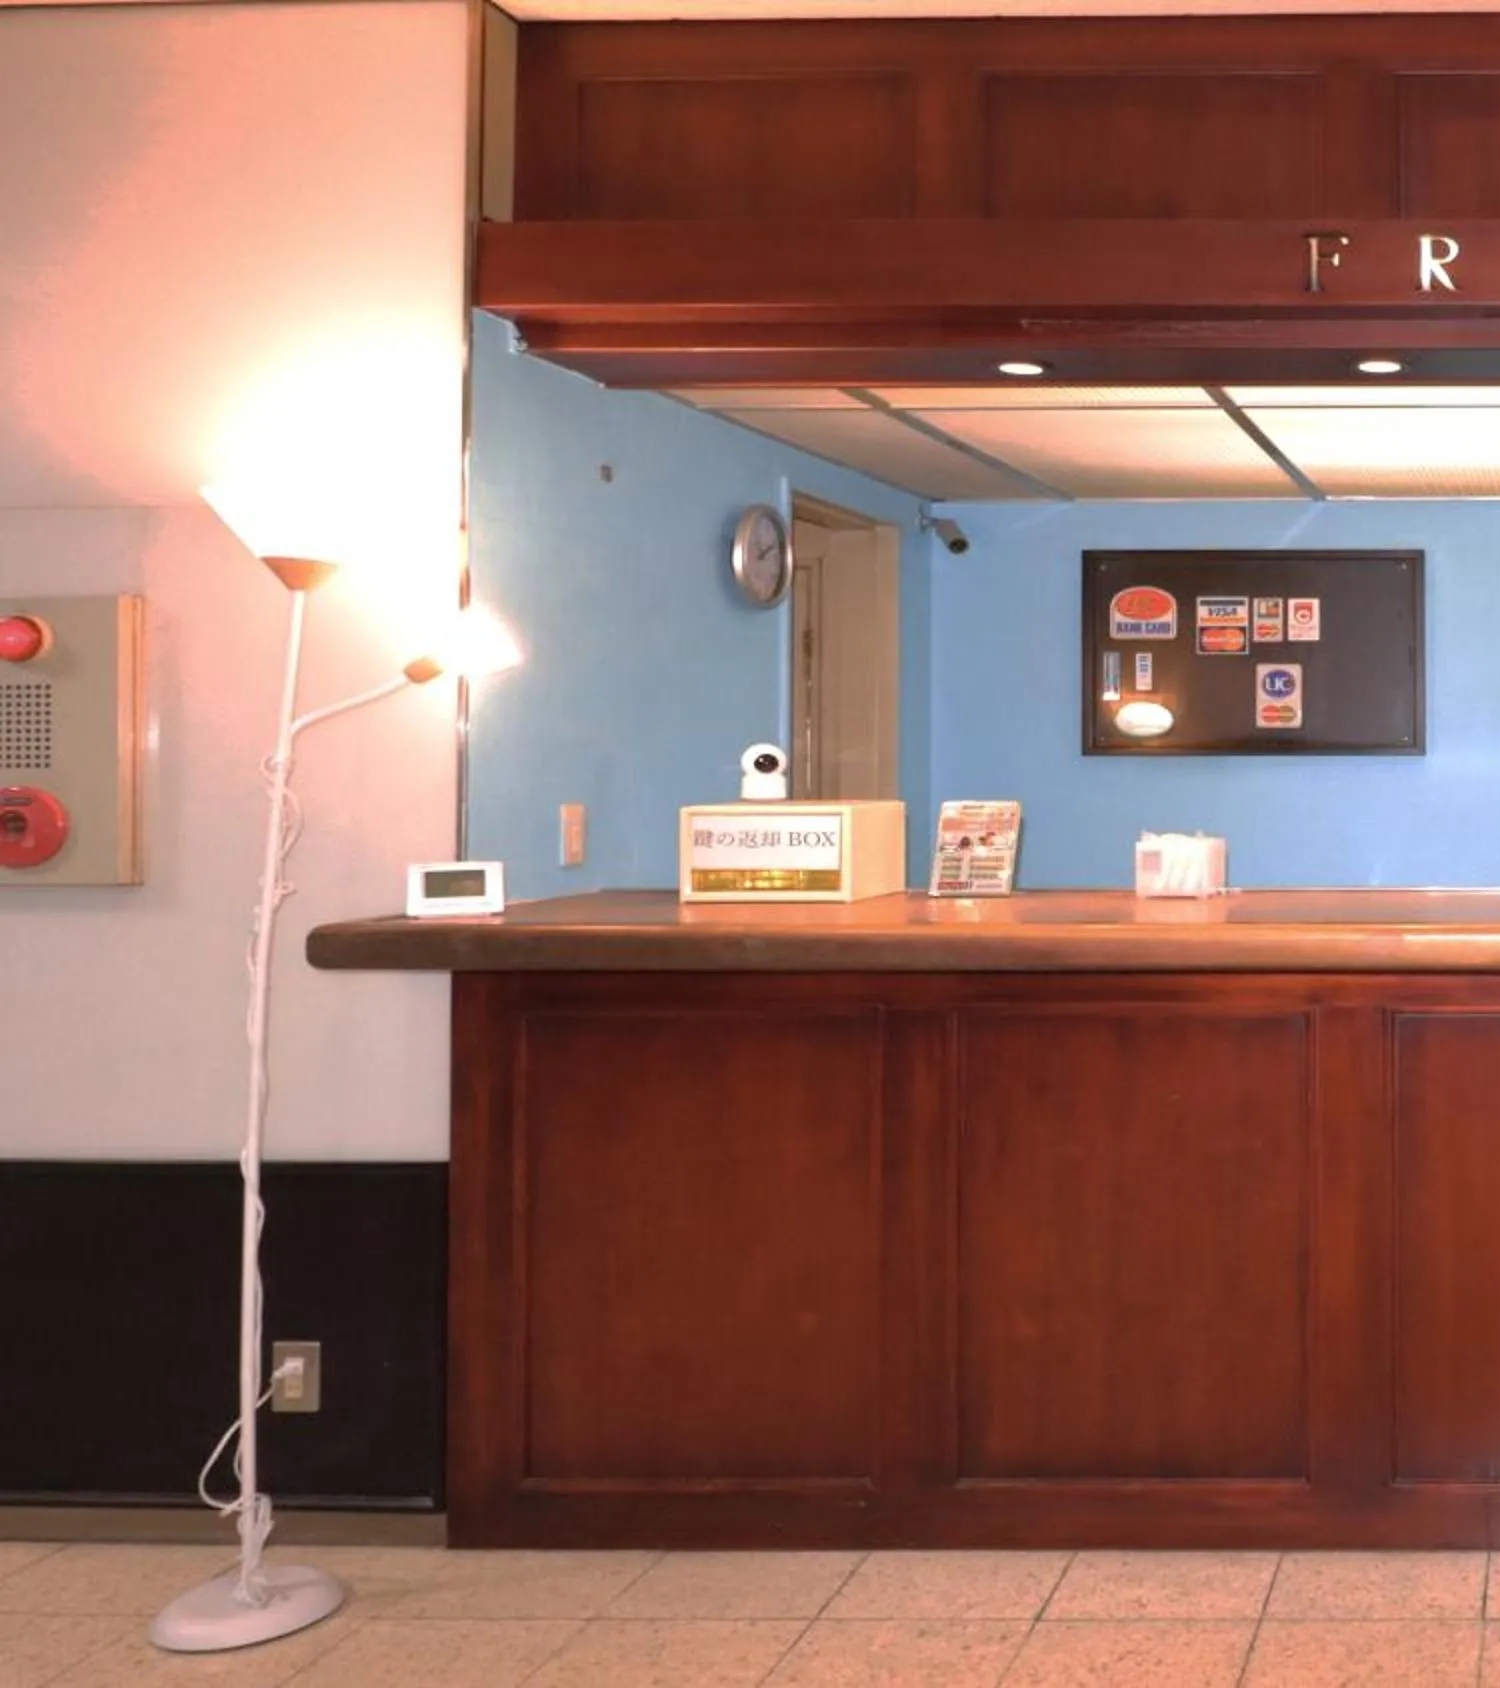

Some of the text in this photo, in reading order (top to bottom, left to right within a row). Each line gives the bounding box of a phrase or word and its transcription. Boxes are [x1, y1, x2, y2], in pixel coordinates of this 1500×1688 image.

[693, 829, 837, 849] 鍵の返却 BOX
